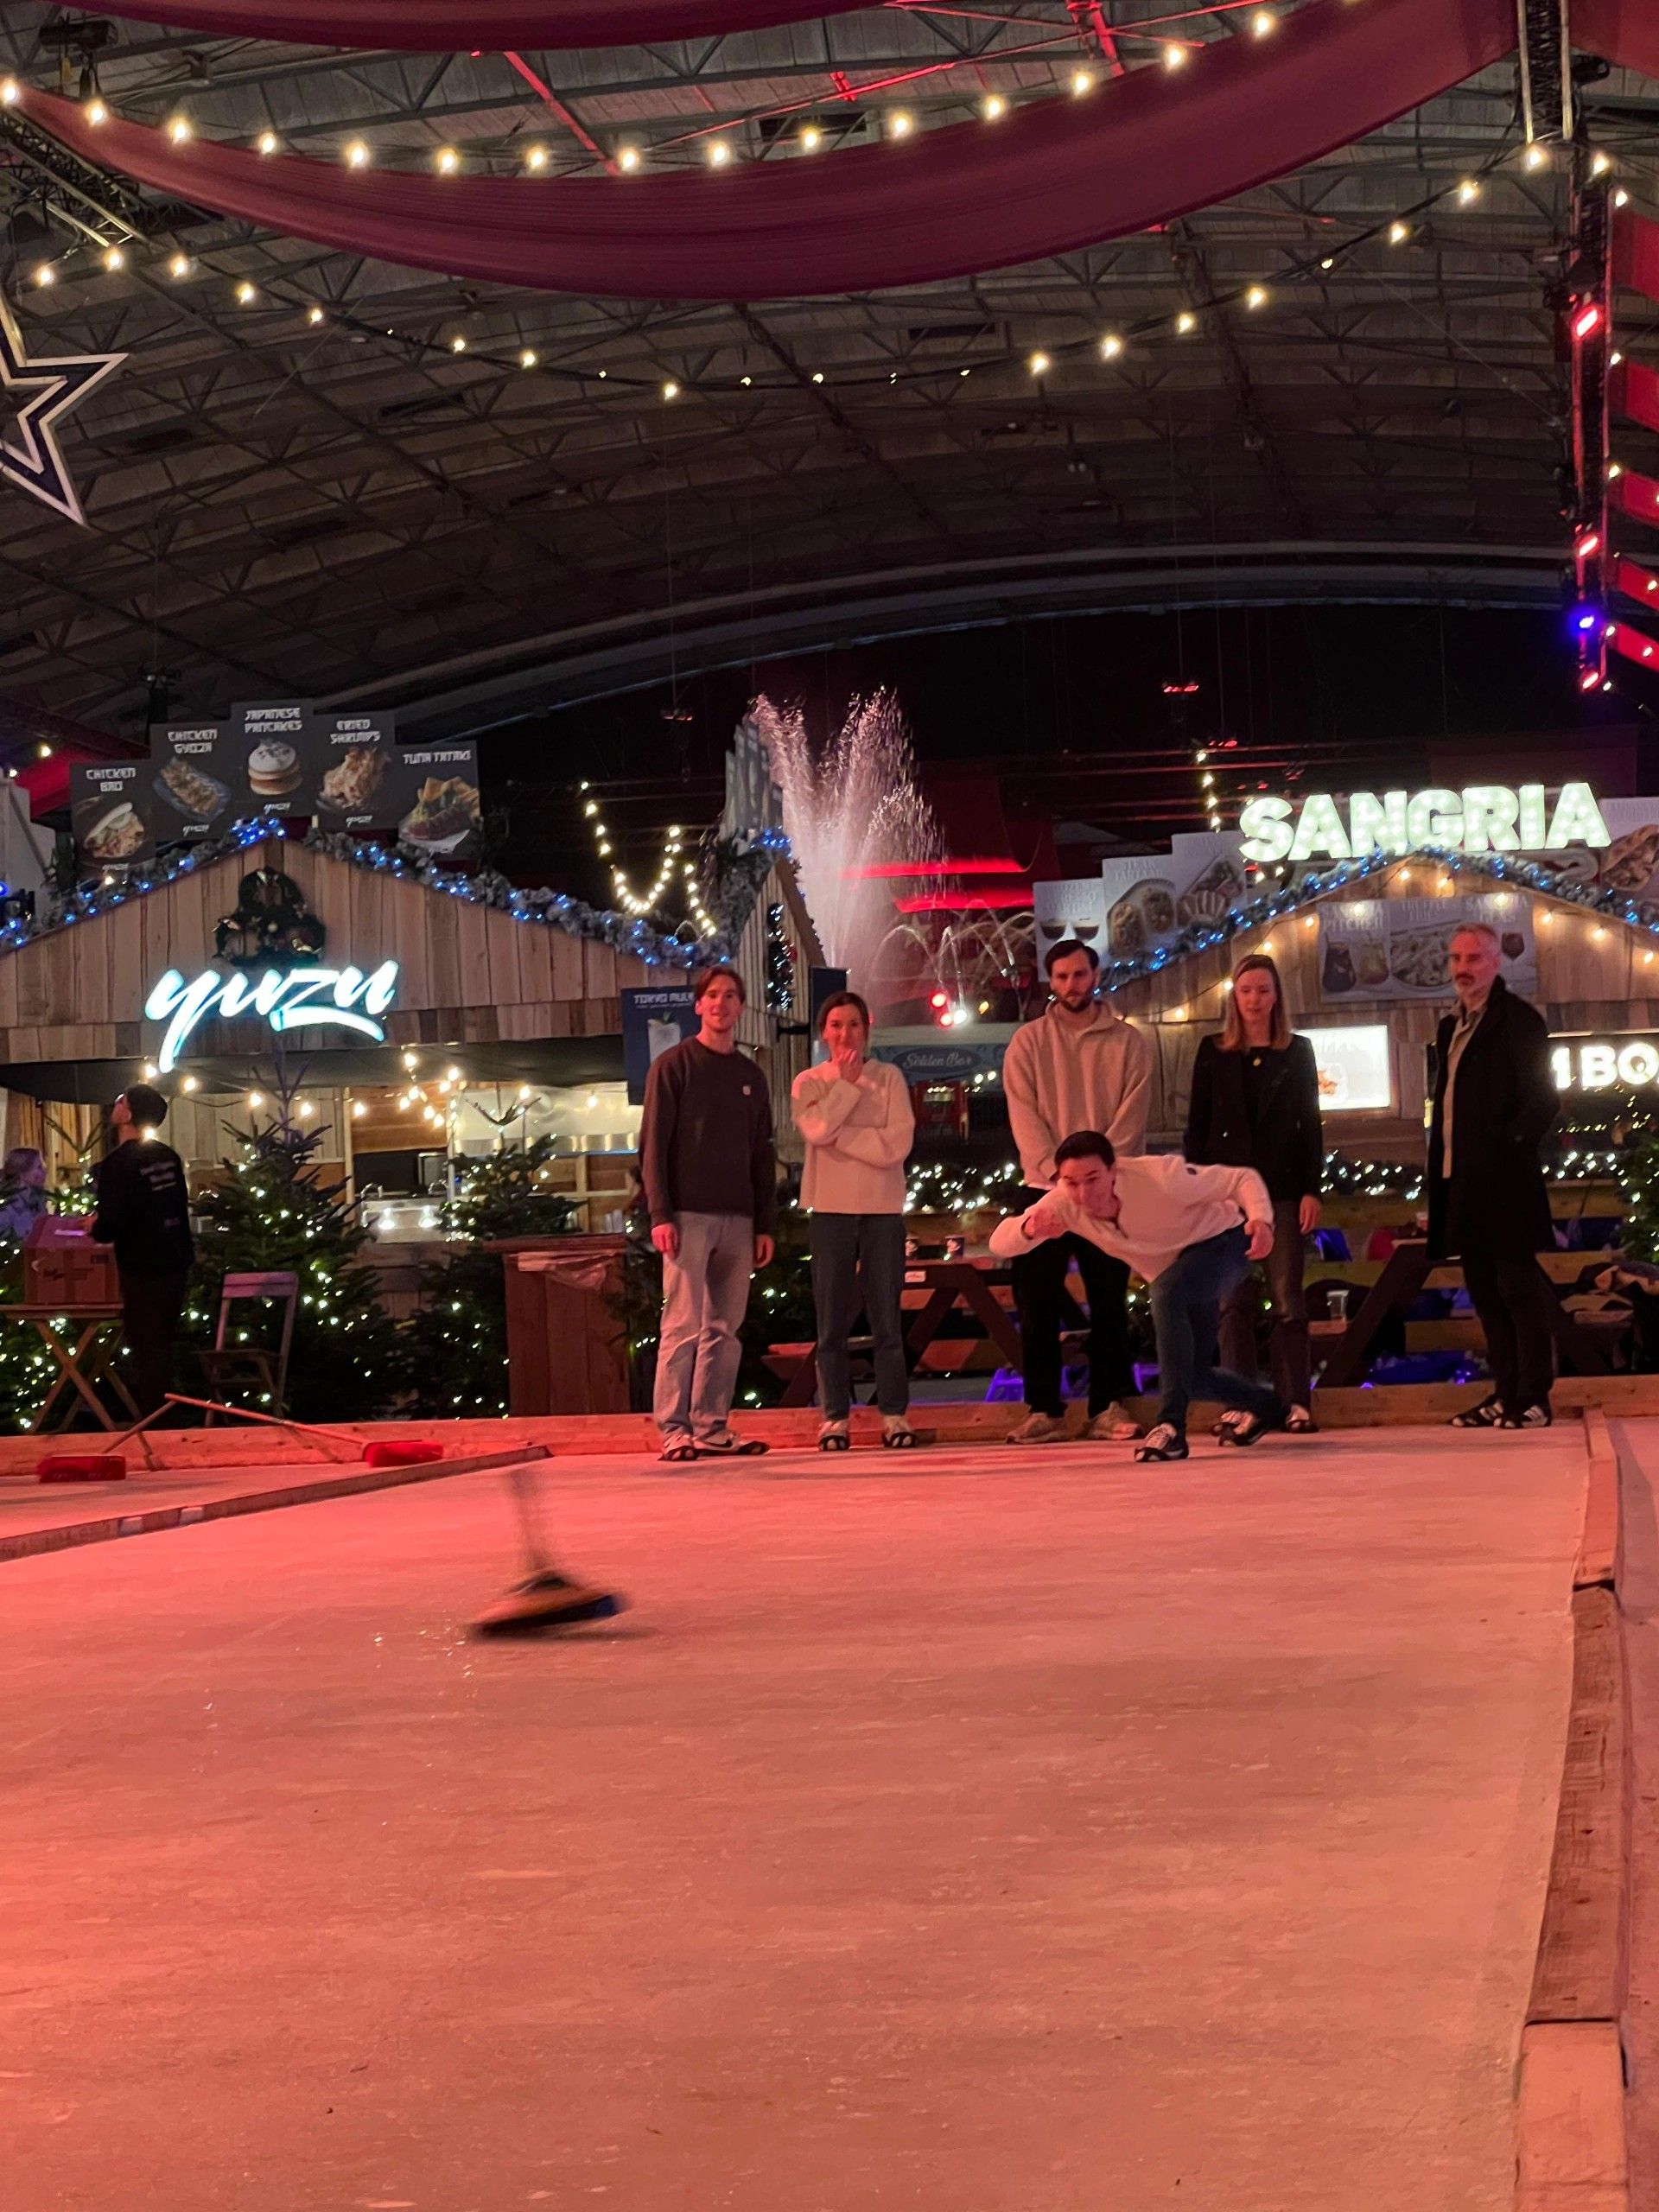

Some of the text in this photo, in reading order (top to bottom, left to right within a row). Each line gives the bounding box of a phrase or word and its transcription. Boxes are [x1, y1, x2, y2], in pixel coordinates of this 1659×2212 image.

[168, 729, 218, 741] CHICKEN
[86, 767, 136, 779] CHICKEN
[1238, 782, 1612, 862] SANGRIA
[145, 959, 399, 1074] yuzu
